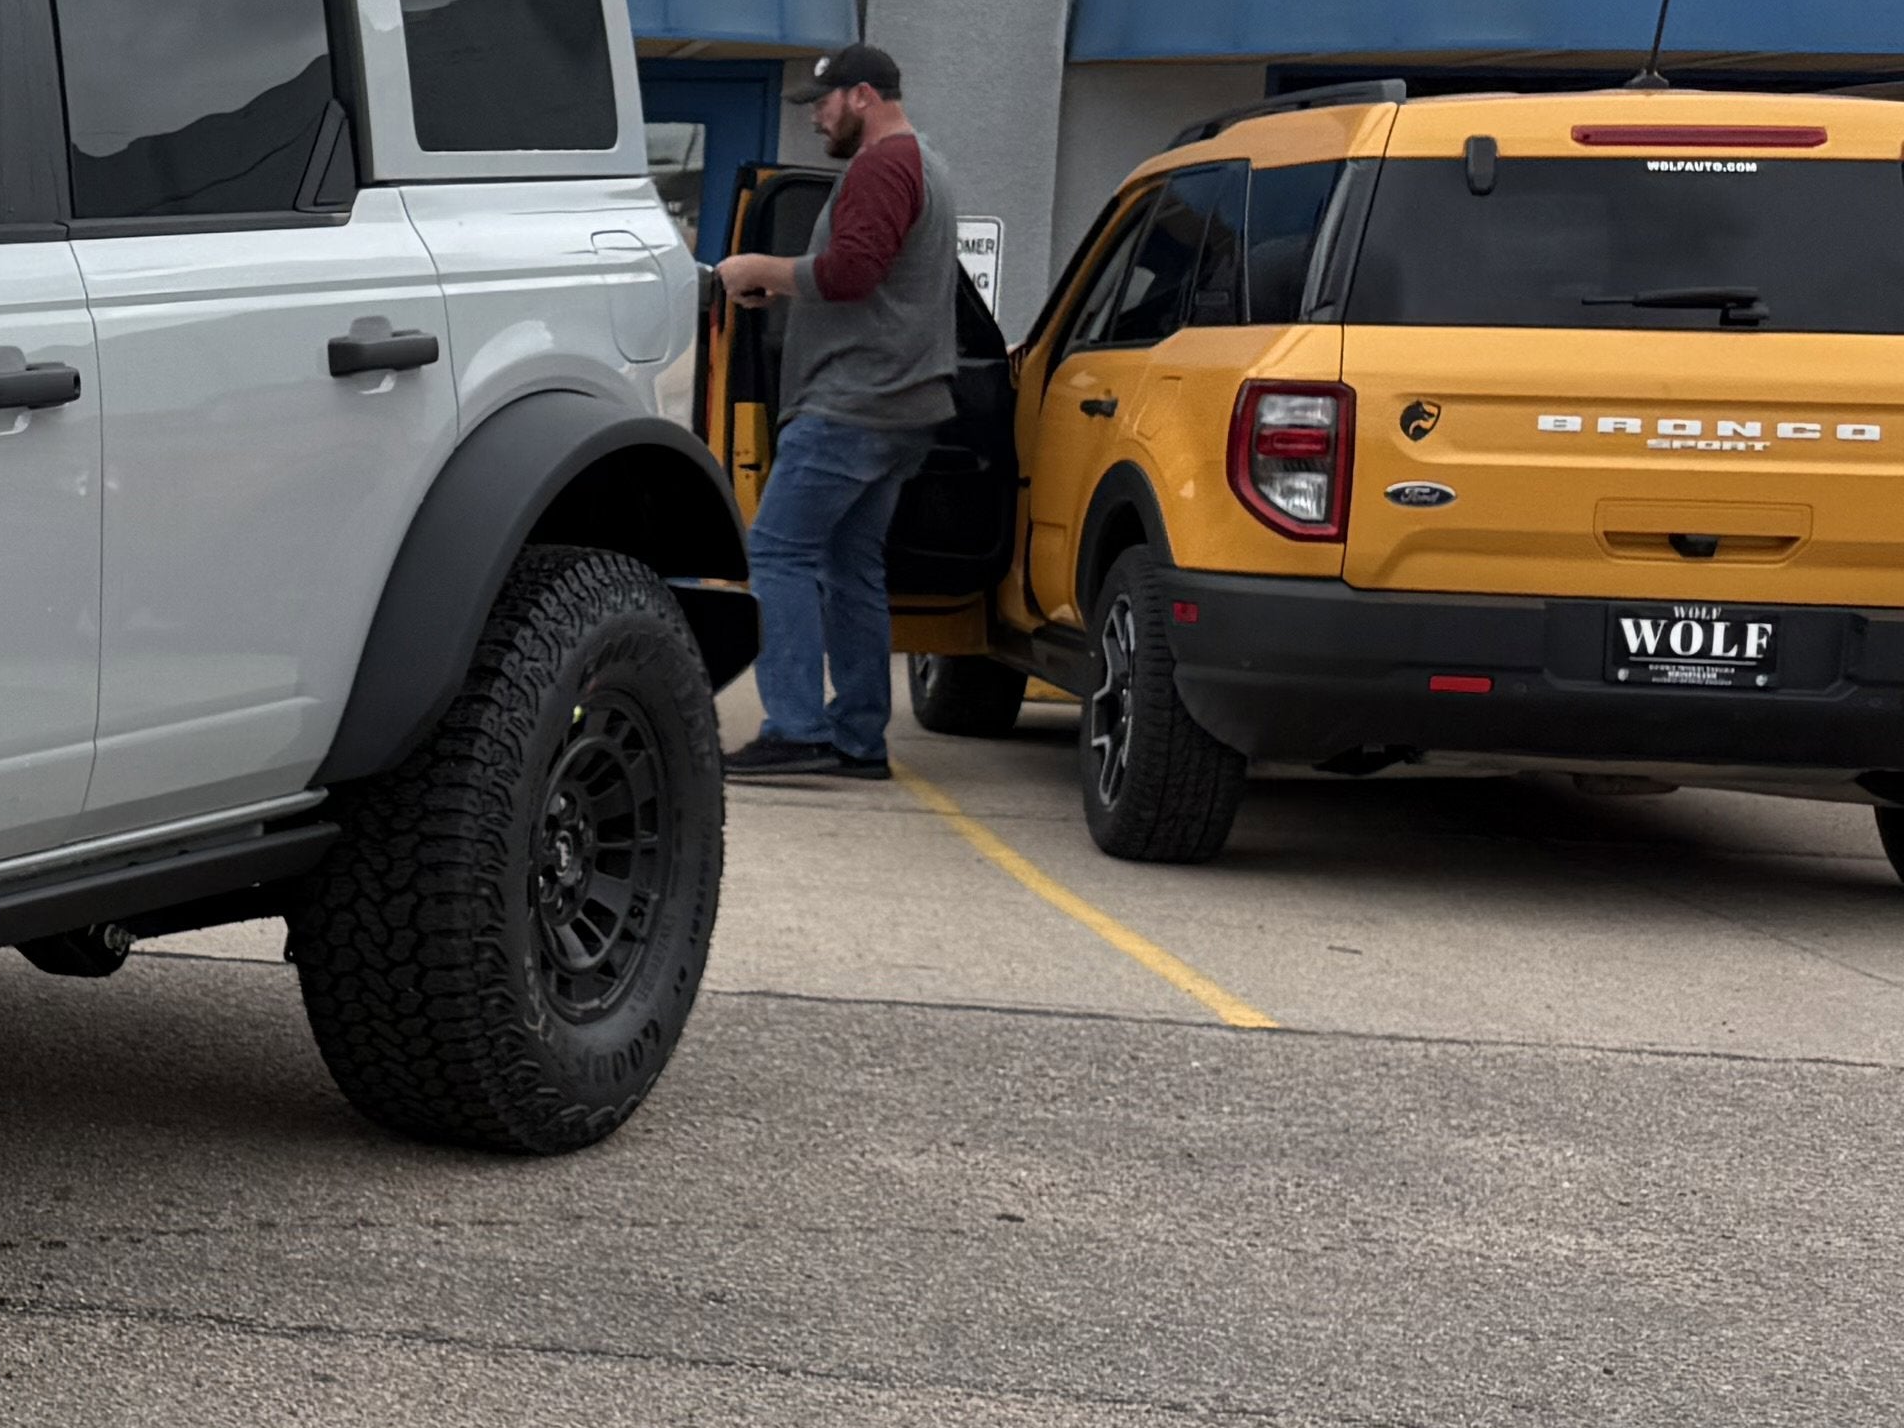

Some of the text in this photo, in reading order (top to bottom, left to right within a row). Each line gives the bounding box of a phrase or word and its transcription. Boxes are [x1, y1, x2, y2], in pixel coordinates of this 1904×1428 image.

[1646, 160, 1758, 173] WOLFAUTO.COM
[1537, 415, 1881, 441] BRONCO
[1646, 438, 1771, 452] SPORT
[1673, 606, 1722, 620] WOLF
[1618, 617, 1773, 659] WOLF
